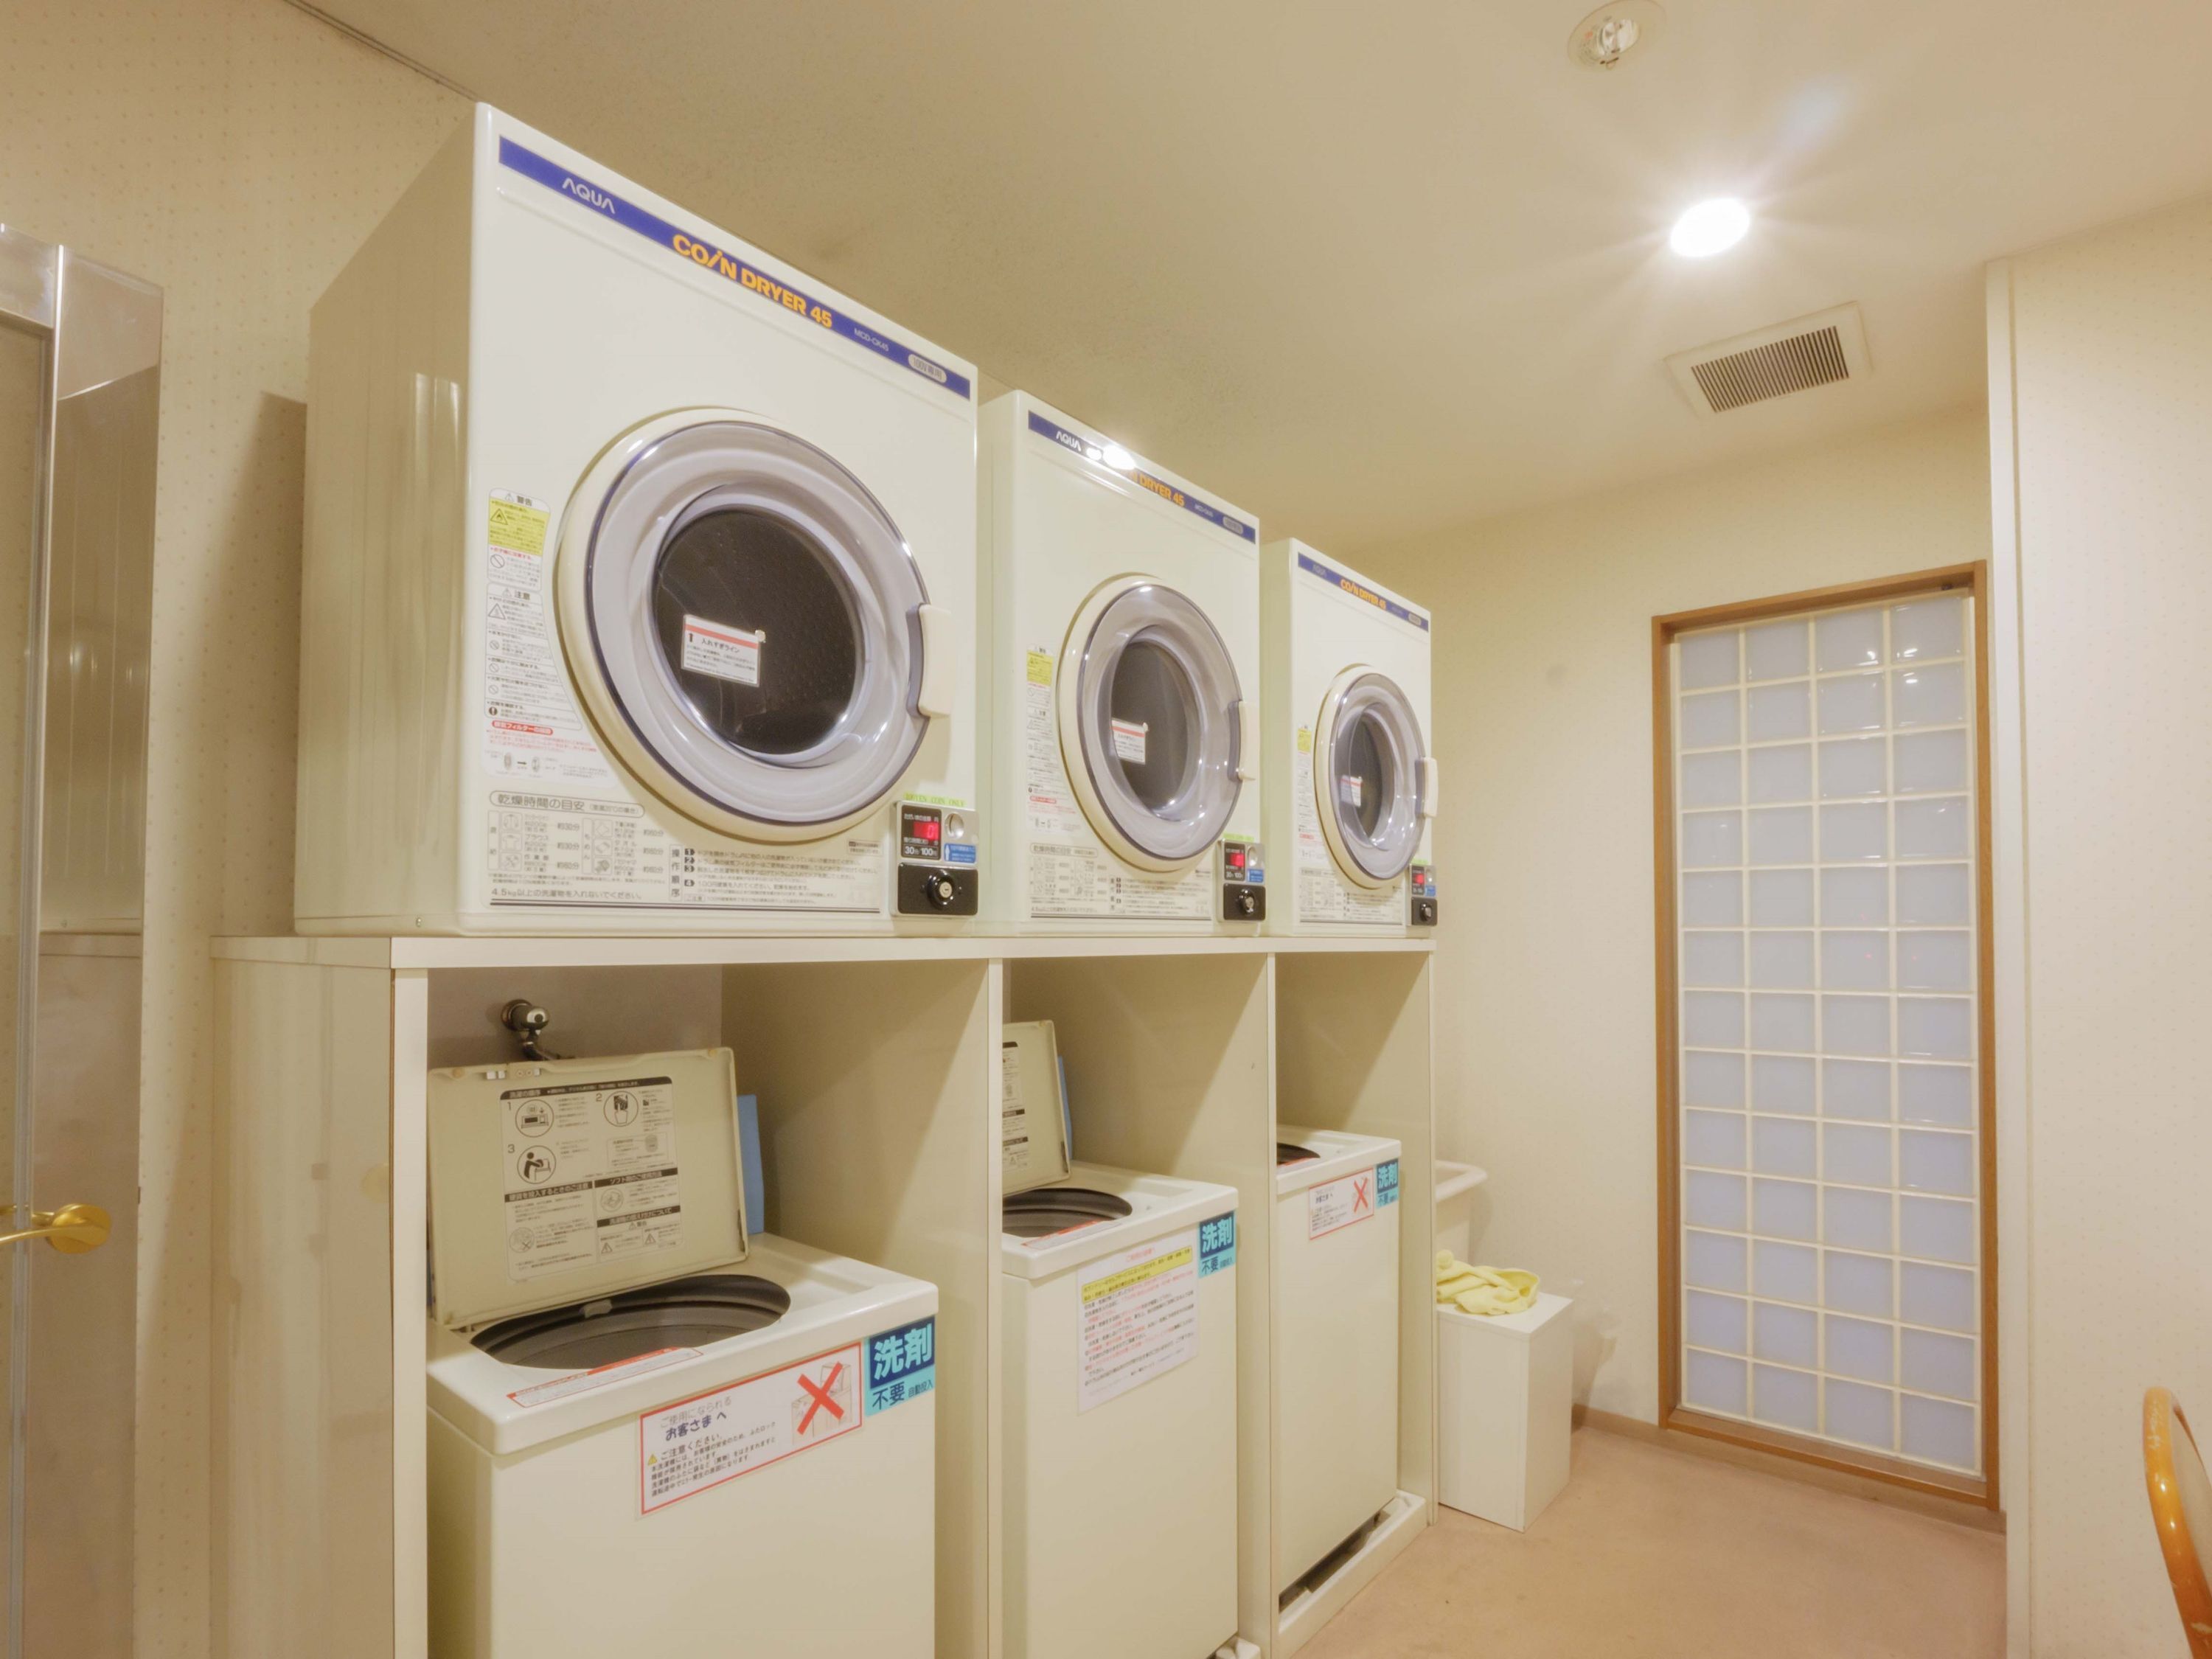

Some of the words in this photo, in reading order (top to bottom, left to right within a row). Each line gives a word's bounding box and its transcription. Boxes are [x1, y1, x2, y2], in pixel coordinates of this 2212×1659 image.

[562, 178, 616, 215] AQUA
[740, 268, 807, 316] DRYER
[810, 305, 832, 330] 45
[1055, 431, 1082, 452] AQUA
[1139, 474, 1172, 501] DRYER
[1172, 492, 1186, 508] 45
[498, 794, 585, 810] 乾燥時間の目安
[507, 1102, 512, 1110] 1
[595, 1093, 602, 1102] 2
[507, 1144, 515, 1153] 3
[1202, 1217, 1233, 1253] 洗剤
[1202, 1256, 1219, 1275] 不要
[873, 1323, 933, 1380] 洗剤
[872, 1381, 905, 1411] 不要
[908, 1379, 933, 1399] 自動投入
[661, 1396, 732, 1428] ご使用になられる
[666, 1411, 727, 1441] お客さまへ
